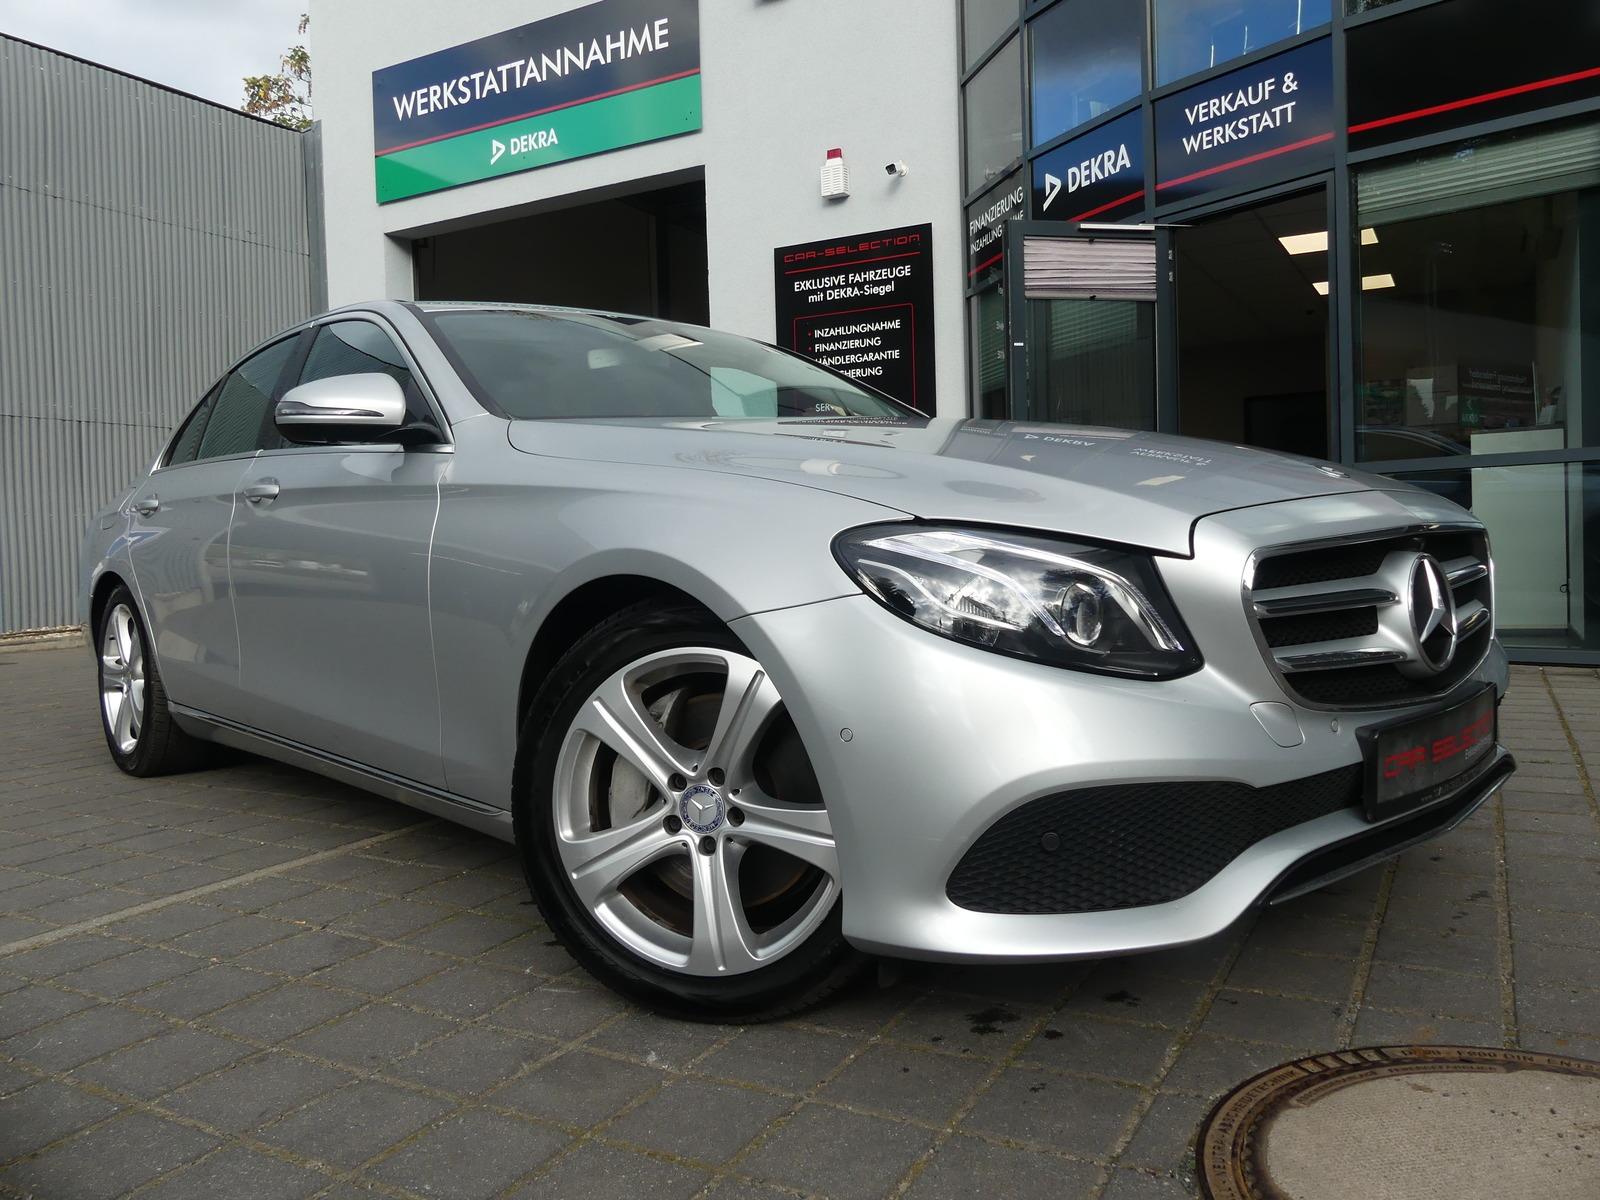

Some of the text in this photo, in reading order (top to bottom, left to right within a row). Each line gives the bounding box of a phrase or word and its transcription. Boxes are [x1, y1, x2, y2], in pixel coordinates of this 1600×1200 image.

[393, 17, 669, 121] WERKSTATTANNAHME
[1185, 72, 1298, 125] VERKAUF &
[510, 128, 558, 156] DEKRA
[1182, 101, 1296, 155] WERKSTATT
[1067, 143, 1132, 194] DEKRA
[969, 186, 1024, 237] FINANZIERUNG
[783, 233, 920, 263] CAR-SELECTION
[794, 265, 911, 292] EXKLUSIVE FAHRZEUGE
[808, 281, 895, 303] mit DEKRA-Siegel
[814, 319, 901, 339] INZAHLUNGNAHME
[814, 337, 882, 353] FINANZIERUNG
[840, 366, 883, 378] HERUNG
